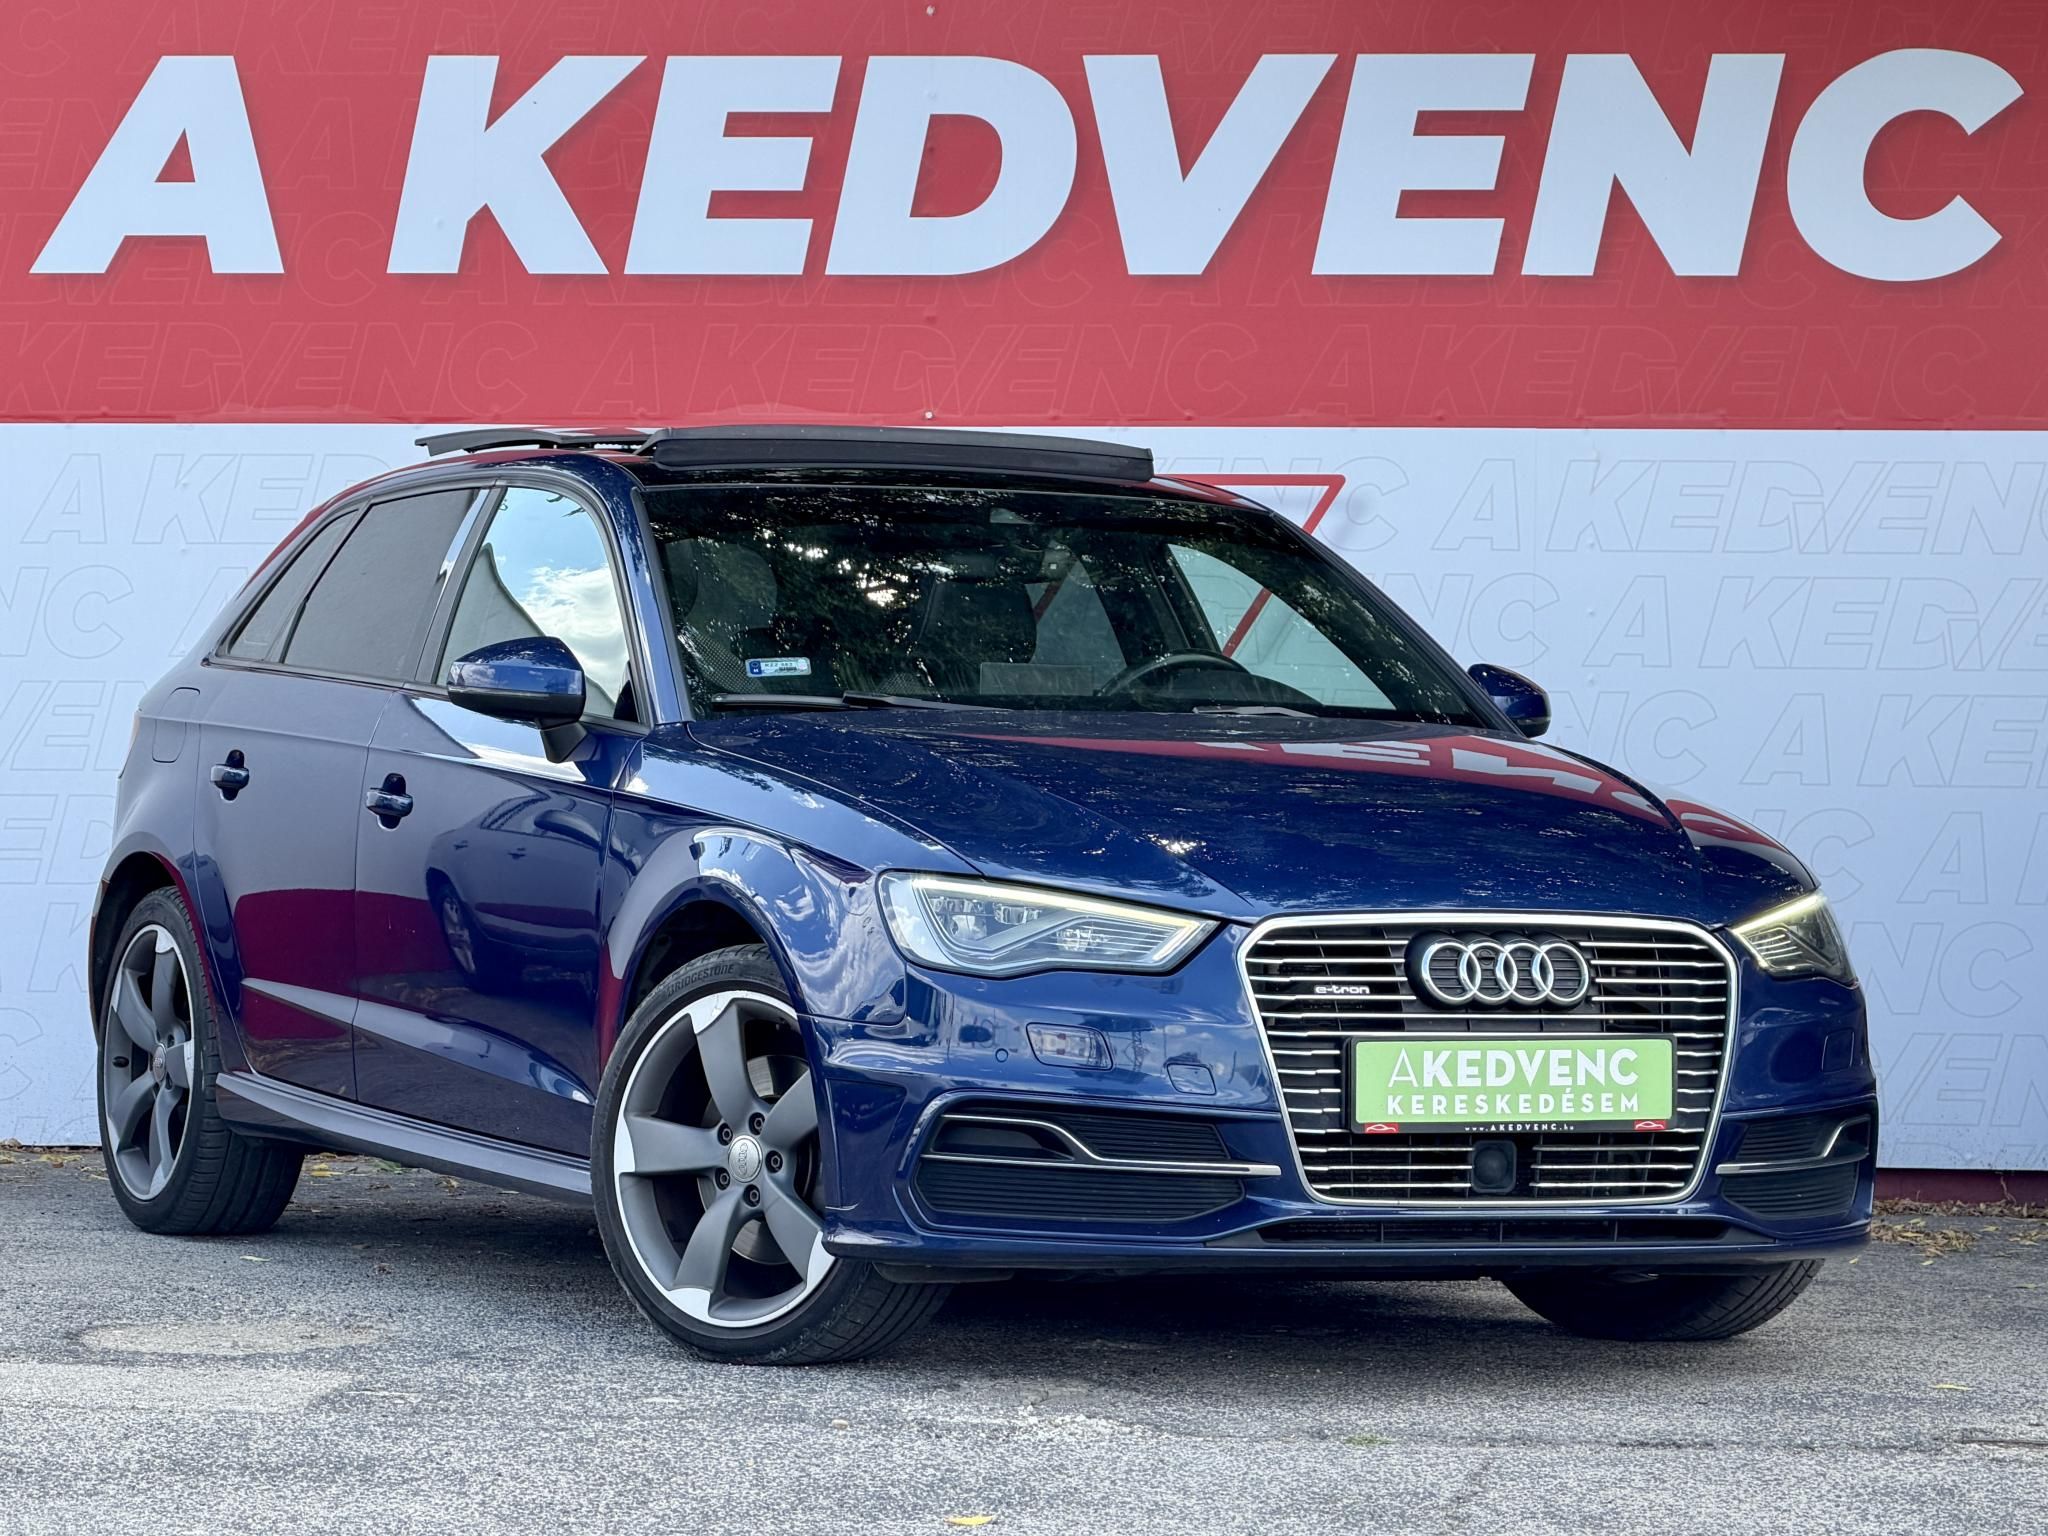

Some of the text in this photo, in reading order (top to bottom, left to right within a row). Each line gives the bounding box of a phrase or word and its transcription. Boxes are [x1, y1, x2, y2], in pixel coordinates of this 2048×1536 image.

[28, 54, 286, 275] A
[386, 47, 2025, 283] KEDVENC
[1431, 458, 1521, 552] A
[1545, 458, 2048, 556] KEDVEN
[1581, 575, 1671, 669] A
[1739, 692, 1832, 787] A
[1895, 811, 1990, 905] A
[667, 963, 734, 997] BRIDGESTONE
[1315, 985, 1370, 994] e-tron
[1388, 1088, 1639, 1116] KERESKEDÉSEM
